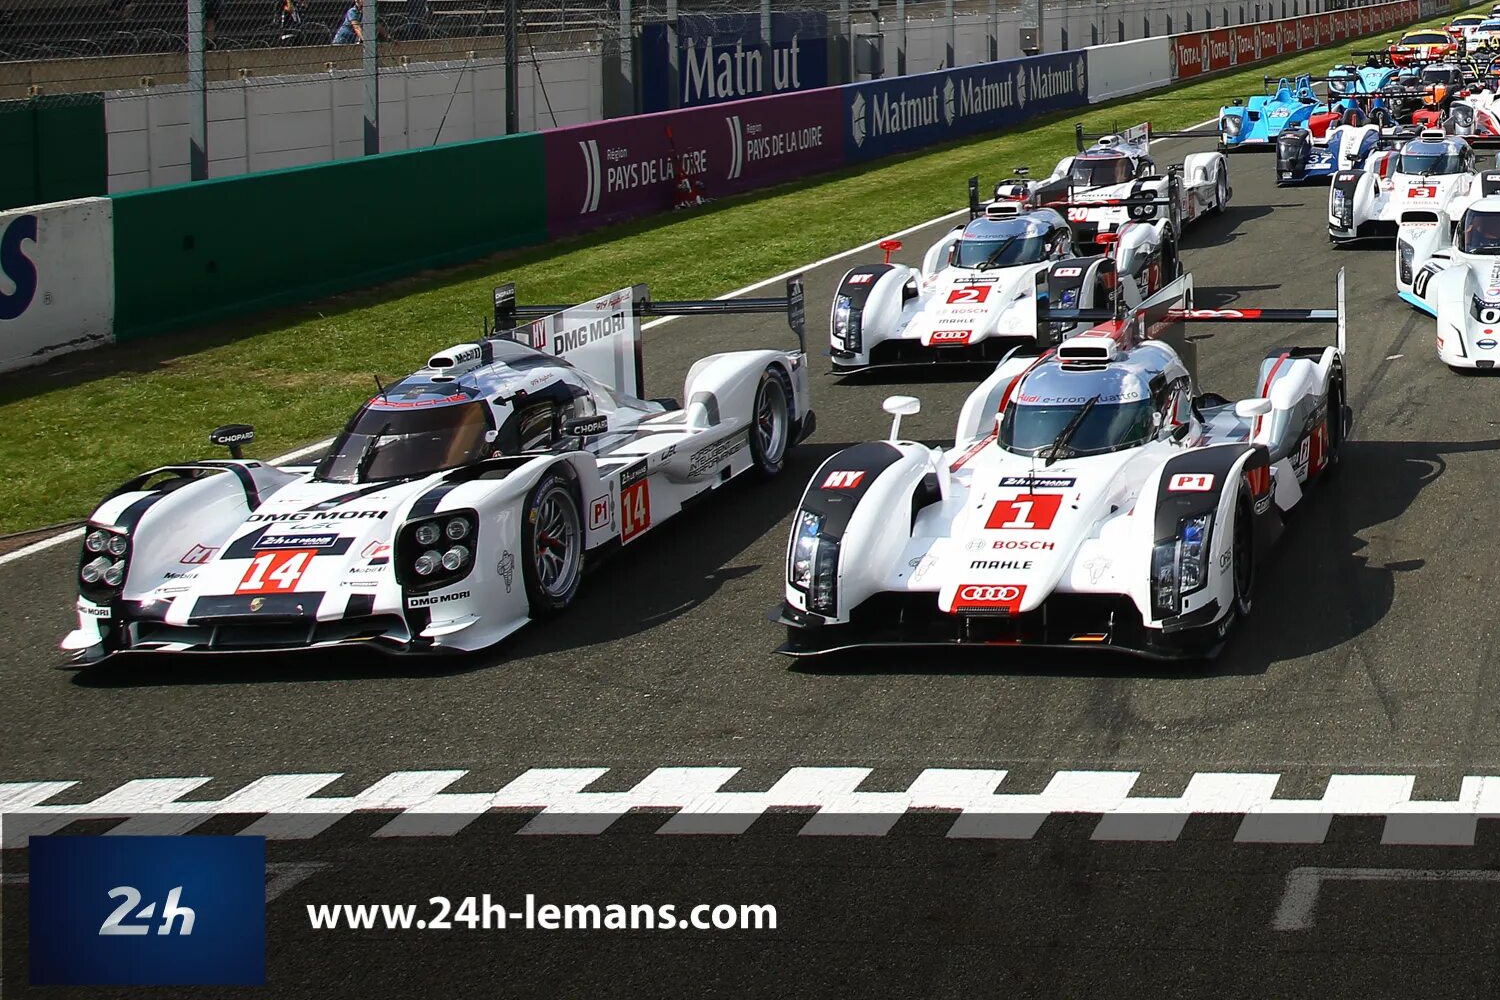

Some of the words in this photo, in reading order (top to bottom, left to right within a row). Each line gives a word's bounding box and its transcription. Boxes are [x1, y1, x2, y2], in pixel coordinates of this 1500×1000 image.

[1179, 45, 1200, 66] TOTAL
[1210, 39, 1229, 60] TOTAL
[1237, 34, 1253, 55] TOTAL
[1261, 31, 1276, 49] TOTAL
[1283, 27, 1297, 44] TOTAL
[873, 86, 938, 137] Matmut
[960, 72, 1013, 117] Matmut
[1030, 62, 1073, 101] Matmut
[747, 123, 763, 134] Région
[747, 137, 770, 162] PAYS
[772, 135, 784, 156] DE
[786, 134, 797, 152] LA
[799, 125, 822, 150] LOIRE
[607, 146, 628, 161] Région
[1309, 155, 1333, 164] 37
[608, 160, 637, 193] PAYS
[641, 159, 656, 186] DE
[659, 157, 674, 180] LA
[676, 150, 707, 175] OIRE
[1415, 187, 1431, 198] 3
[1068, 208, 1088, 222] 20
[850, 275, 871, 284] HY
[1059, 268, 1078, 276] P1
[953, 289, 980, 303] 2
[1480, 308, 1500, 324] 0
[533, 320, 545, 348] HY
[555, 330, 587, 355] DMG
[590, 312, 624, 342] MORI
[1018, 393, 1040, 403] Audi
[574, 419, 608, 434] CHOPARD
[218, 432, 254, 443] CHOPARD
[825, 471, 862, 486] HY
[1177, 476, 1206, 487] P1
[247, 512, 306, 523] DMG
[322, 510, 388, 520] MORI
[594, 500, 608, 523] P1
[624, 485, 646, 535] 14
[1000, 501, 1036, 529] 1
[992, 540, 1055, 551] BOSCH
[240, 552, 308, 590] 14
[970, 560, 1033, 570] MAHLE
[410, 595, 438, 607] DMG
[440, 591, 470, 603] MORI
[88, 607, 109, 615] MORI
